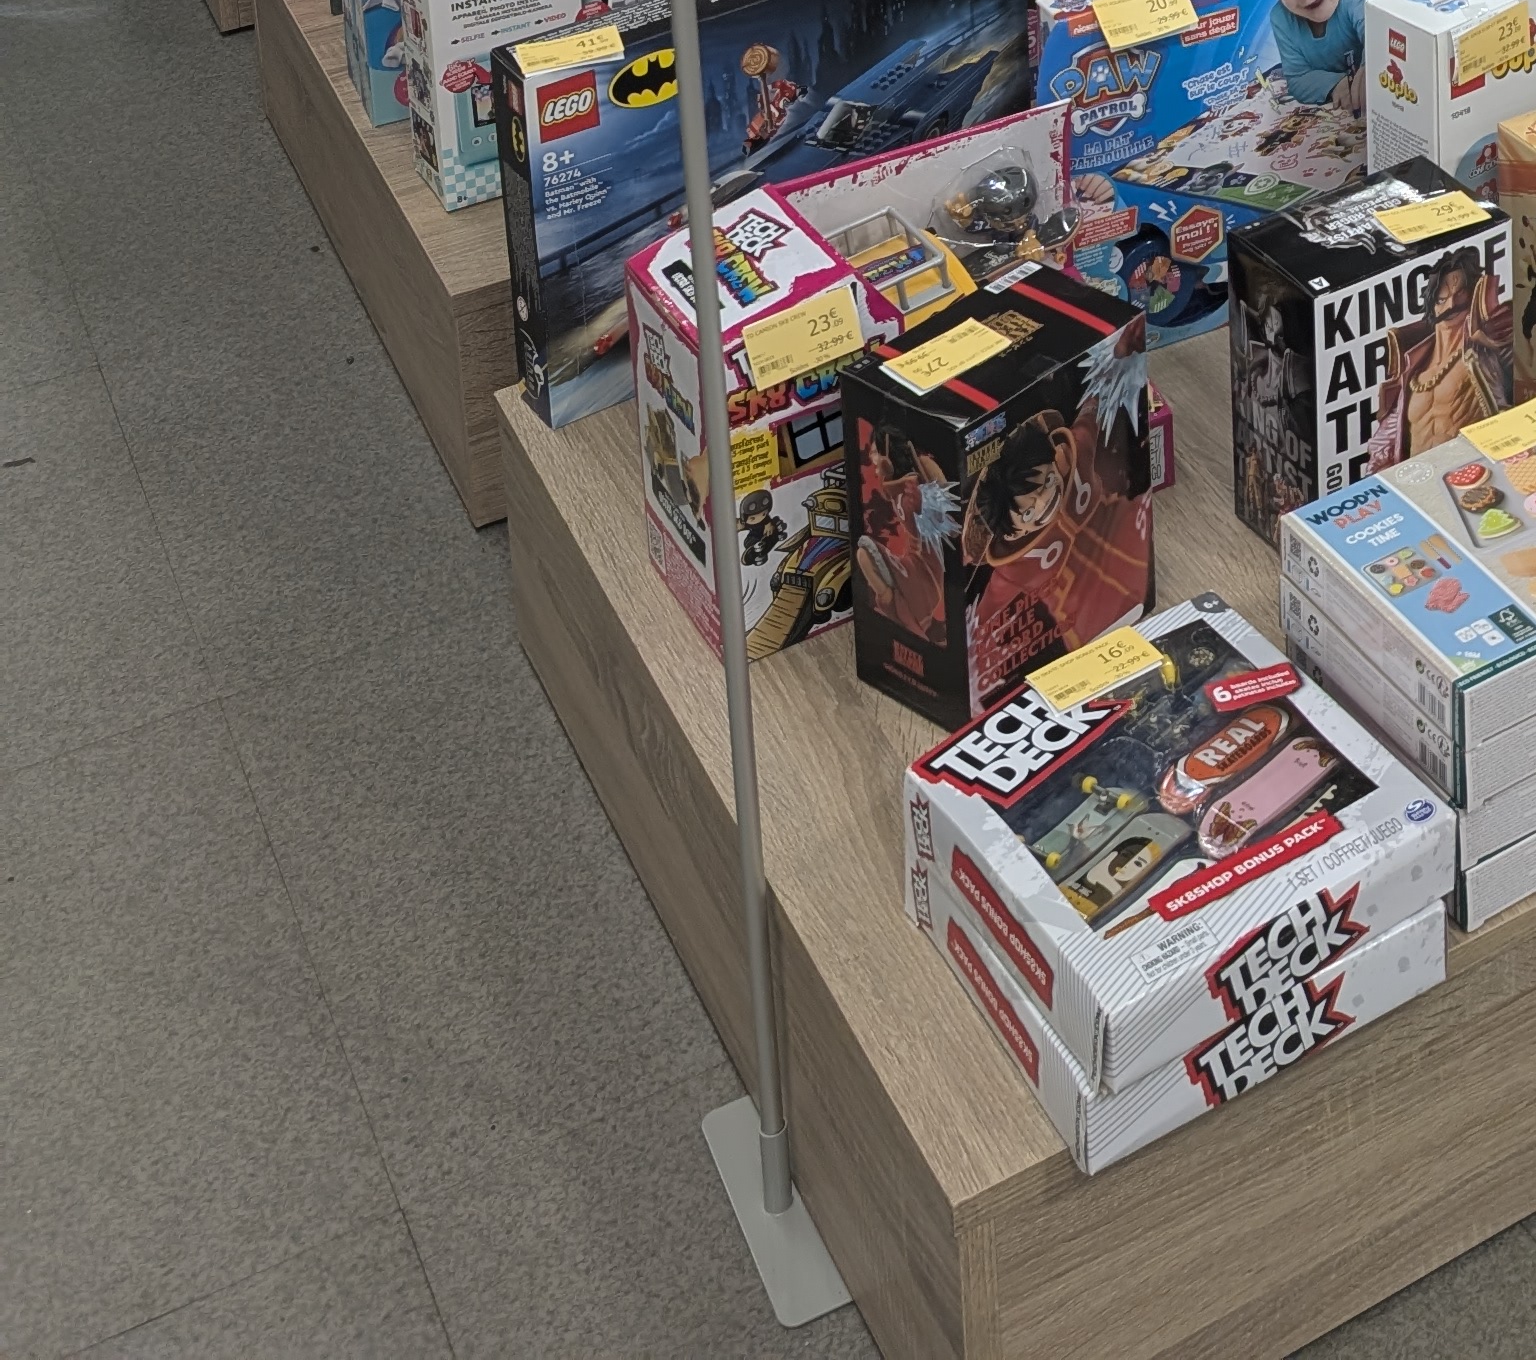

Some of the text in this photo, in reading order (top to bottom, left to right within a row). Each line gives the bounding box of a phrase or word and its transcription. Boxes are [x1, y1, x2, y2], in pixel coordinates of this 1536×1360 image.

[544, 13, 566, 23] VIDEO
[1051, 50, 1161, 105] PAW
[543, 89, 593, 123] LEGO
[1080, 101, 1138, 126] PATROL
[543, 150, 574, 172] 8+
[1070, 136, 1154, 170] PATROUILLE
[544, 168, 581, 186] 76274
[730, 226, 769, 261] DECK
[744, 212, 784, 245] TECH
[1323, 267, 1433, 350] KING
[1306, 483, 1389, 526] WOOD'N
[1333, 500, 1382, 529] PLAY
[1345, 513, 1404, 546] COOKIES
[1368, 528, 1400, 548] TIME
[1194, 716, 1266, 768] REAL
[1216, 731, 1272, 772] SKATEBOARDS
[1166, 844, 1286, 912] SK8SHOP BONUS
[1299, 866, 1318, 886] SET
